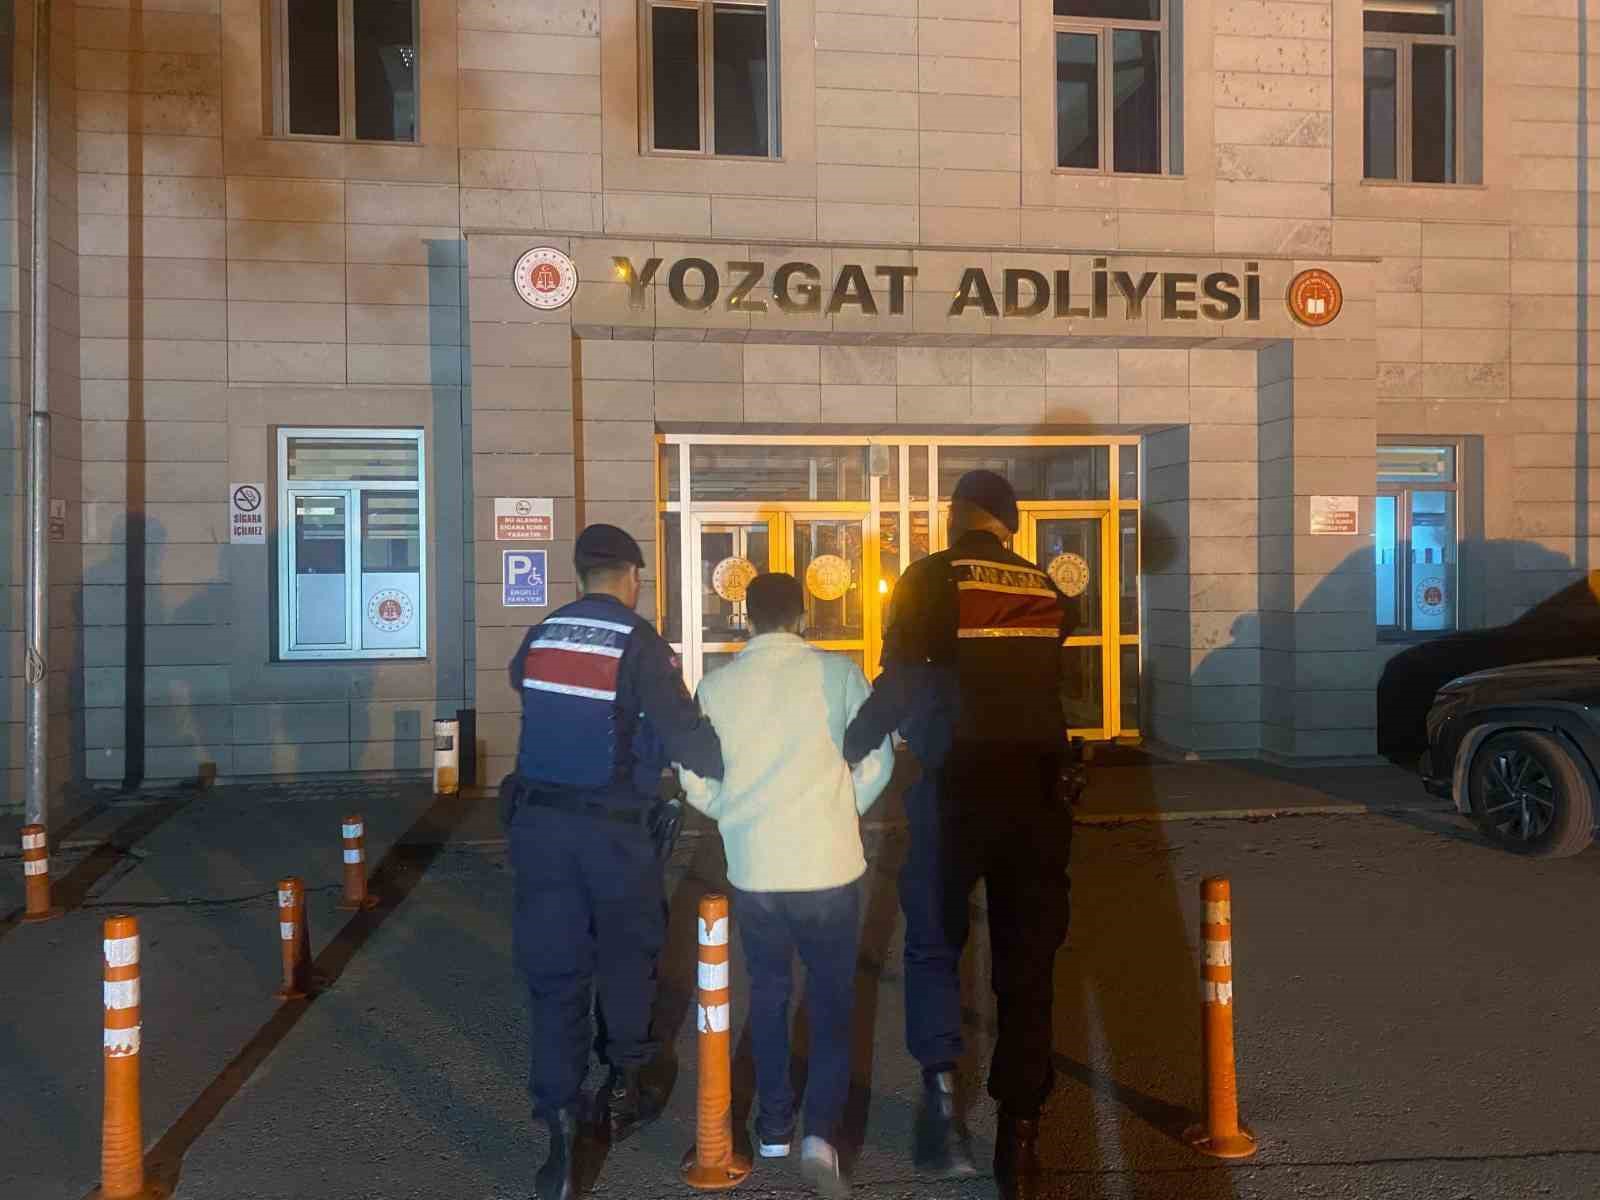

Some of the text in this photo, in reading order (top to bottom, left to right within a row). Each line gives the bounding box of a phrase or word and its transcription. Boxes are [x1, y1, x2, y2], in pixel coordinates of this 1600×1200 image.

[611, 255, 919, 316] YOZGAT
[948, 256, 1260, 321] ADLİYESİ
[508, 555, 531, 585] P
